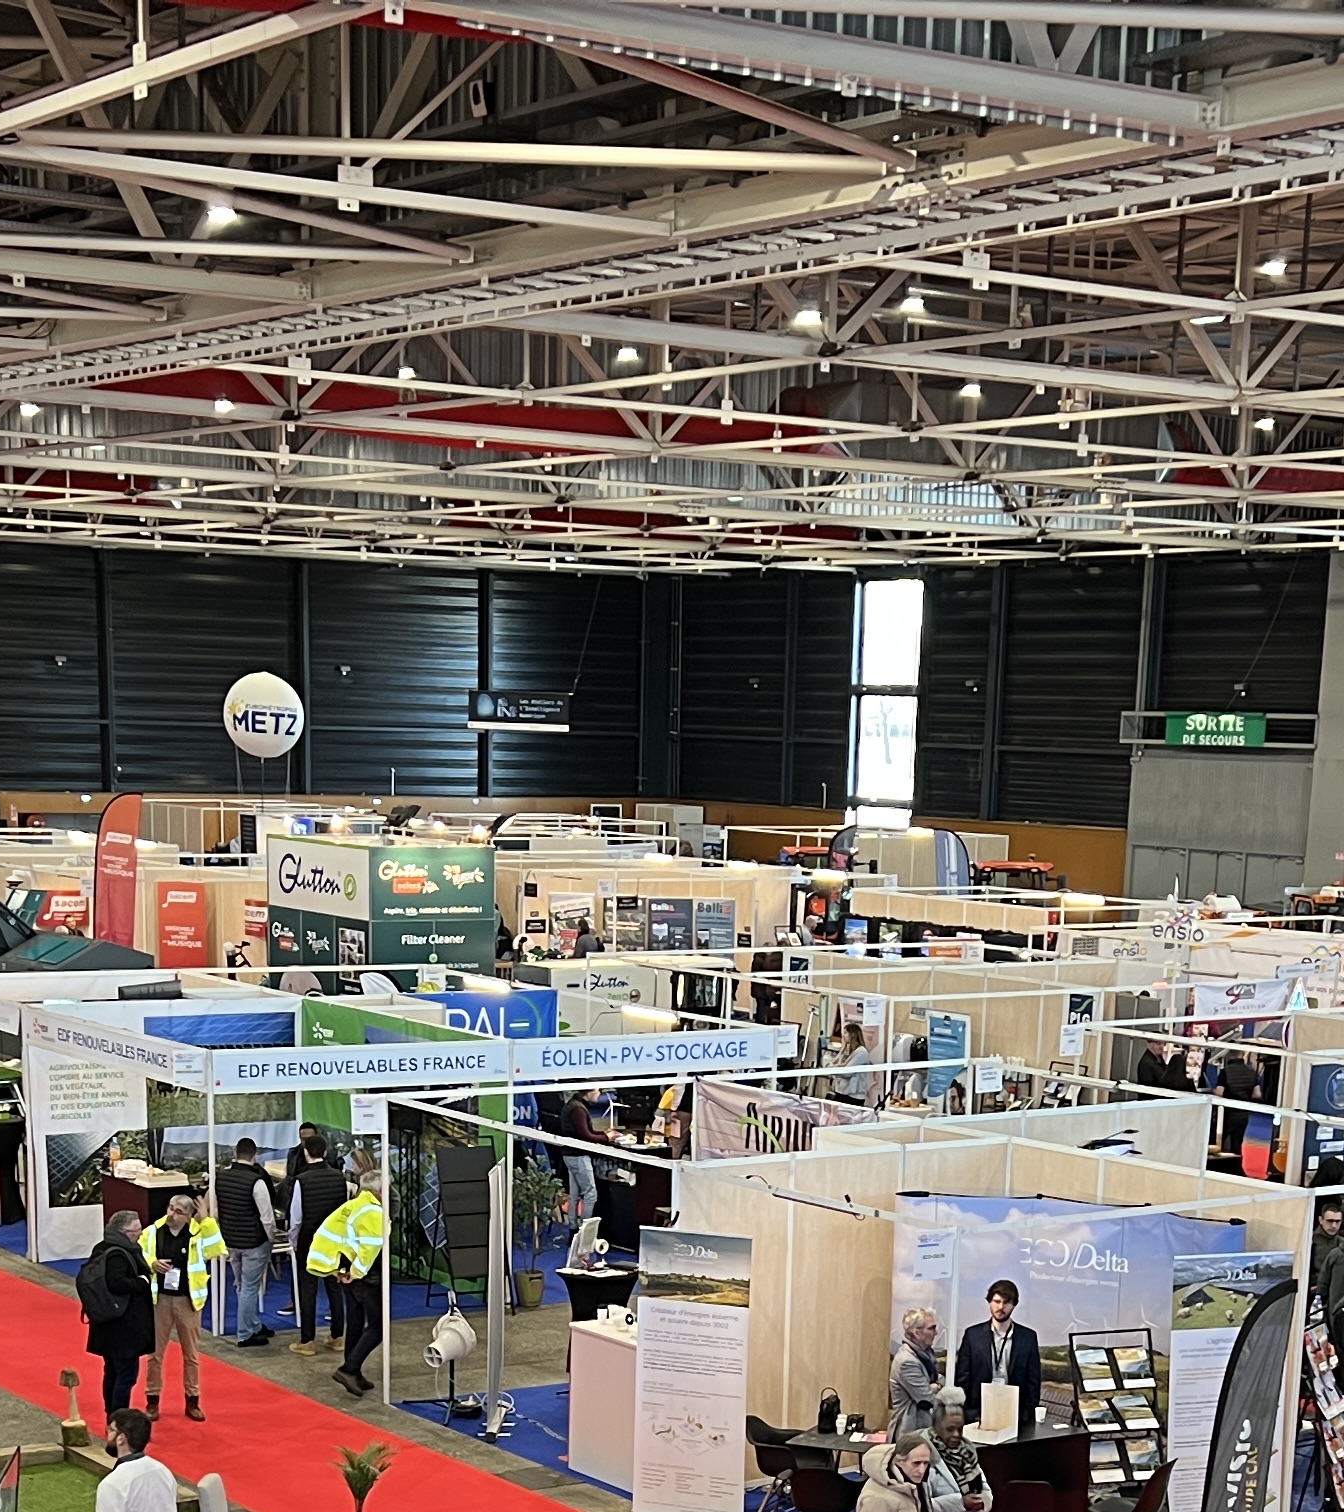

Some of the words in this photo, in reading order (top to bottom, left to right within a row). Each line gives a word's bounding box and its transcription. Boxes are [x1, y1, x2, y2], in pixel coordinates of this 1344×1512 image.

[233, 710, 297, 736] METZ
[1185, 714, 1245, 732] SORTIE
[1182, 733, 1199, 745] DE
[1203, 734, 1245, 746] SECOURS
[279, 853, 341, 896] Glutton
[378, 859, 428, 881] Glutton
[55, 898, 86, 908] sacem
[1153, 922, 1205, 942] ensio
[401, 934, 427, 945] Filter
[429, 934, 466, 945] Cleaner
[1113, 944, 1148, 958] ensio
[57, 1027, 71, 1042] EDF
[72, 1031, 135, 1061] RENOUVELABLES
[136, 1047, 168, 1069] FRANCE
[541, 1044, 608, 1068] ÉOLIEN
[621, 1046, 645, 1064] PV
[655, 1041, 748, 1062] STOCKAGE
[238, 1063, 269, 1079] EDF
[275, 1056, 418, 1078] RENOUVELABLES
[423, 1054, 486, 1071] FRANCE
[82, 1072, 93, 1080] AU
[94, 1071, 124, 1079] SERVICE
[49, 1083, 64, 1091] DES
[50, 1093, 61, 1101] DU
[101, 1091, 129, 1099] ANIMAL
[60, 1103, 75, 1111] DES
[51, 1112, 92, 1120] AGRICOLES
